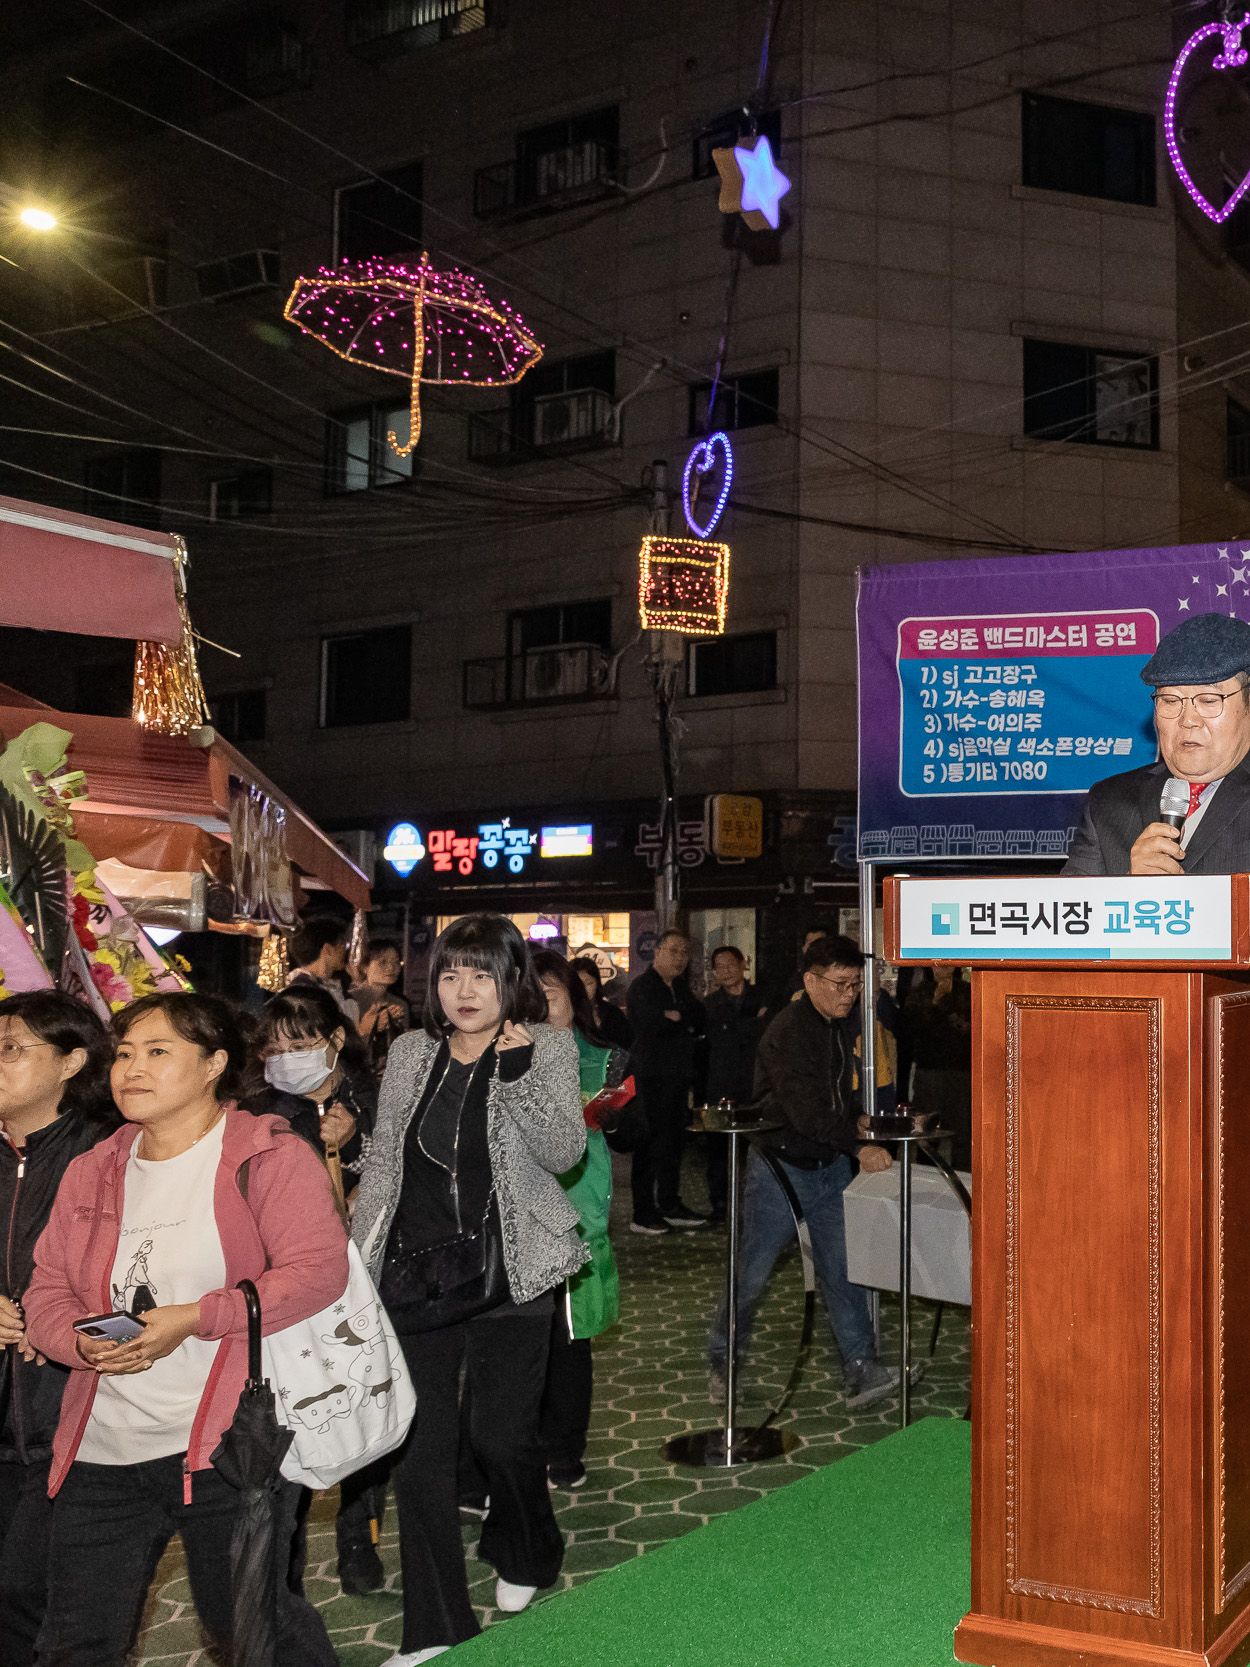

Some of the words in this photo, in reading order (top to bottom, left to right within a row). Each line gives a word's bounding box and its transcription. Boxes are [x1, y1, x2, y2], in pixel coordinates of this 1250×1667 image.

[917, 628, 979, 650] 윤성준
[983, 624, 1088, 649] 밴드마스터
[1094, 622, 1137, 647] 공연
[920, 666, 937, 685] 1)
[942, 665, 959, 689] sj
[963, 665, 1038, 685] 고고장구
[1017, 737, 1133, 757] 색소폰앙상블
[1001, 760, 1048, 781] 7080
[968, 901, 1093, 936] 면곡시장
[1102, 899, 1195, 936] 교육장
[119, 1219, 188, 1239] bonjour
